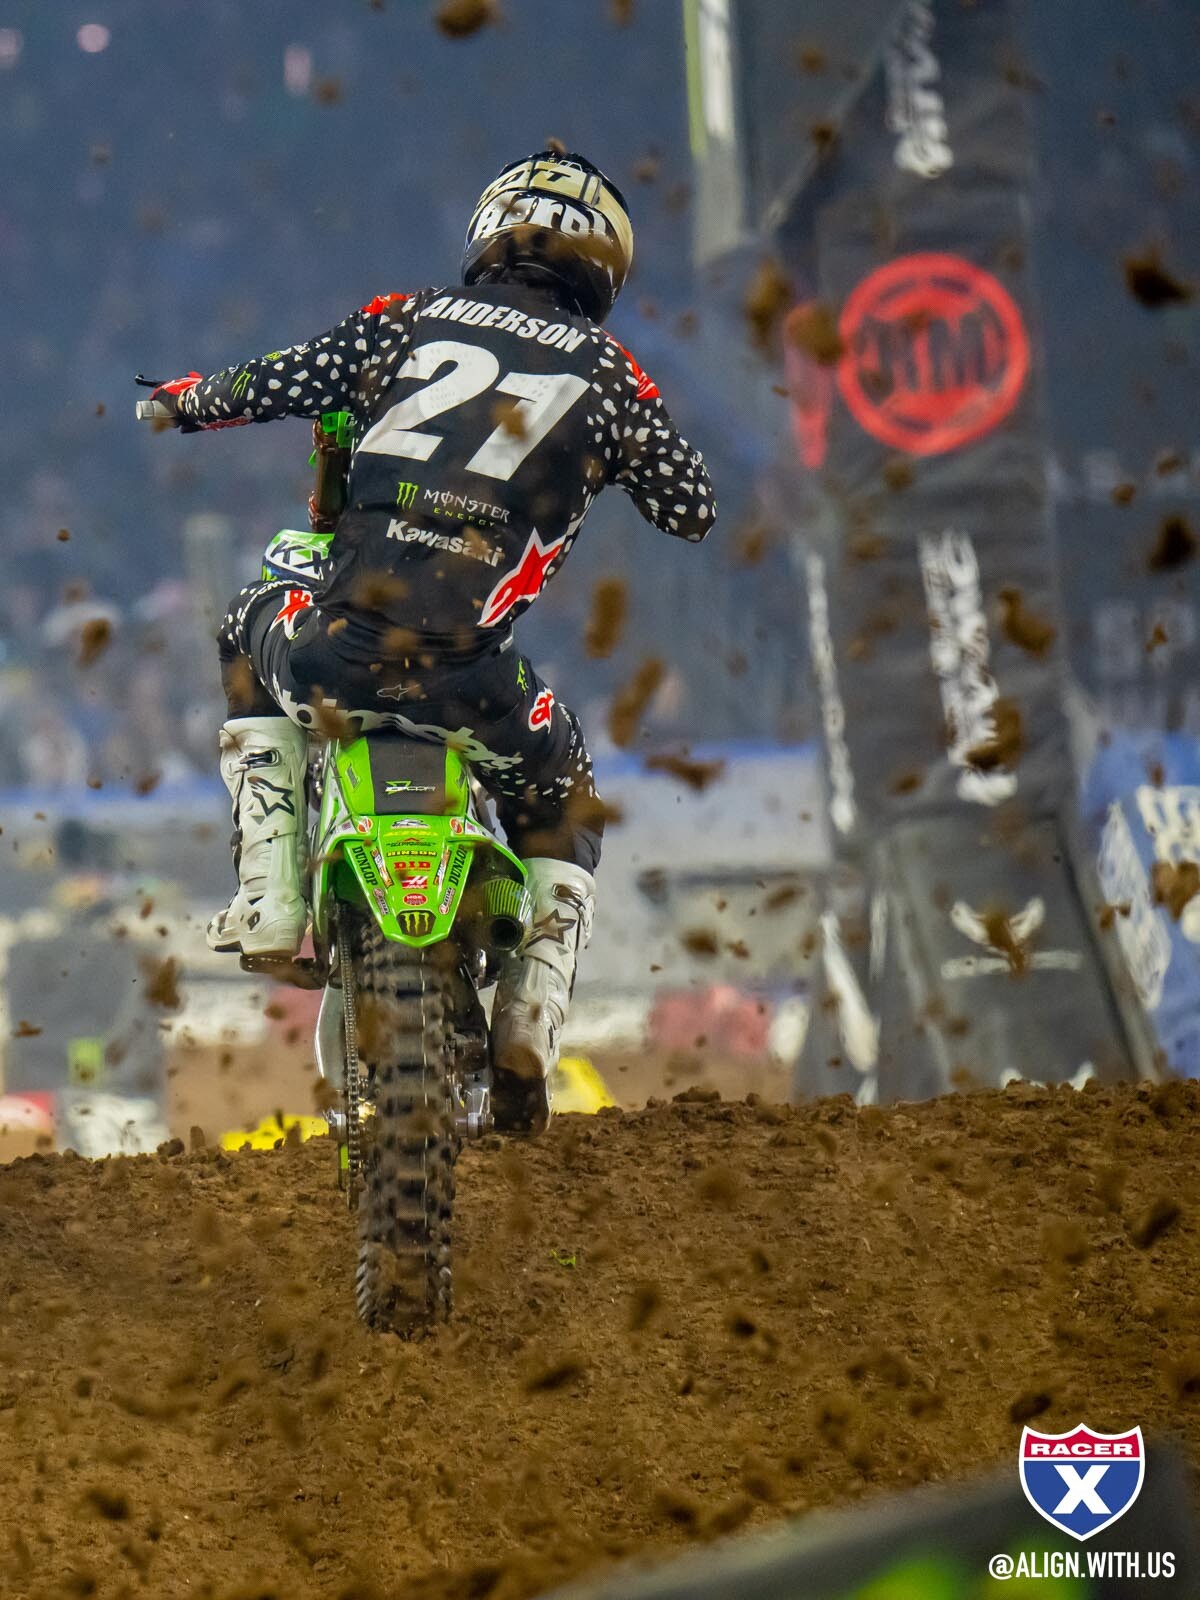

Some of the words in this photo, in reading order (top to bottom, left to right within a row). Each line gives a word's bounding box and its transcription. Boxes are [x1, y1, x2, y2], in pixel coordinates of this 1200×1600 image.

[419, 296, 588, 354] ANDERSON
[423, 489, 511, 523] MONSTER
[433, 507, 496, 527] ENERGY
[386, 518, 506, 567] Kawasaki
[352, 846, 378, 886] DUNLOP
[448, 844, 469, 886] DUNLOP
